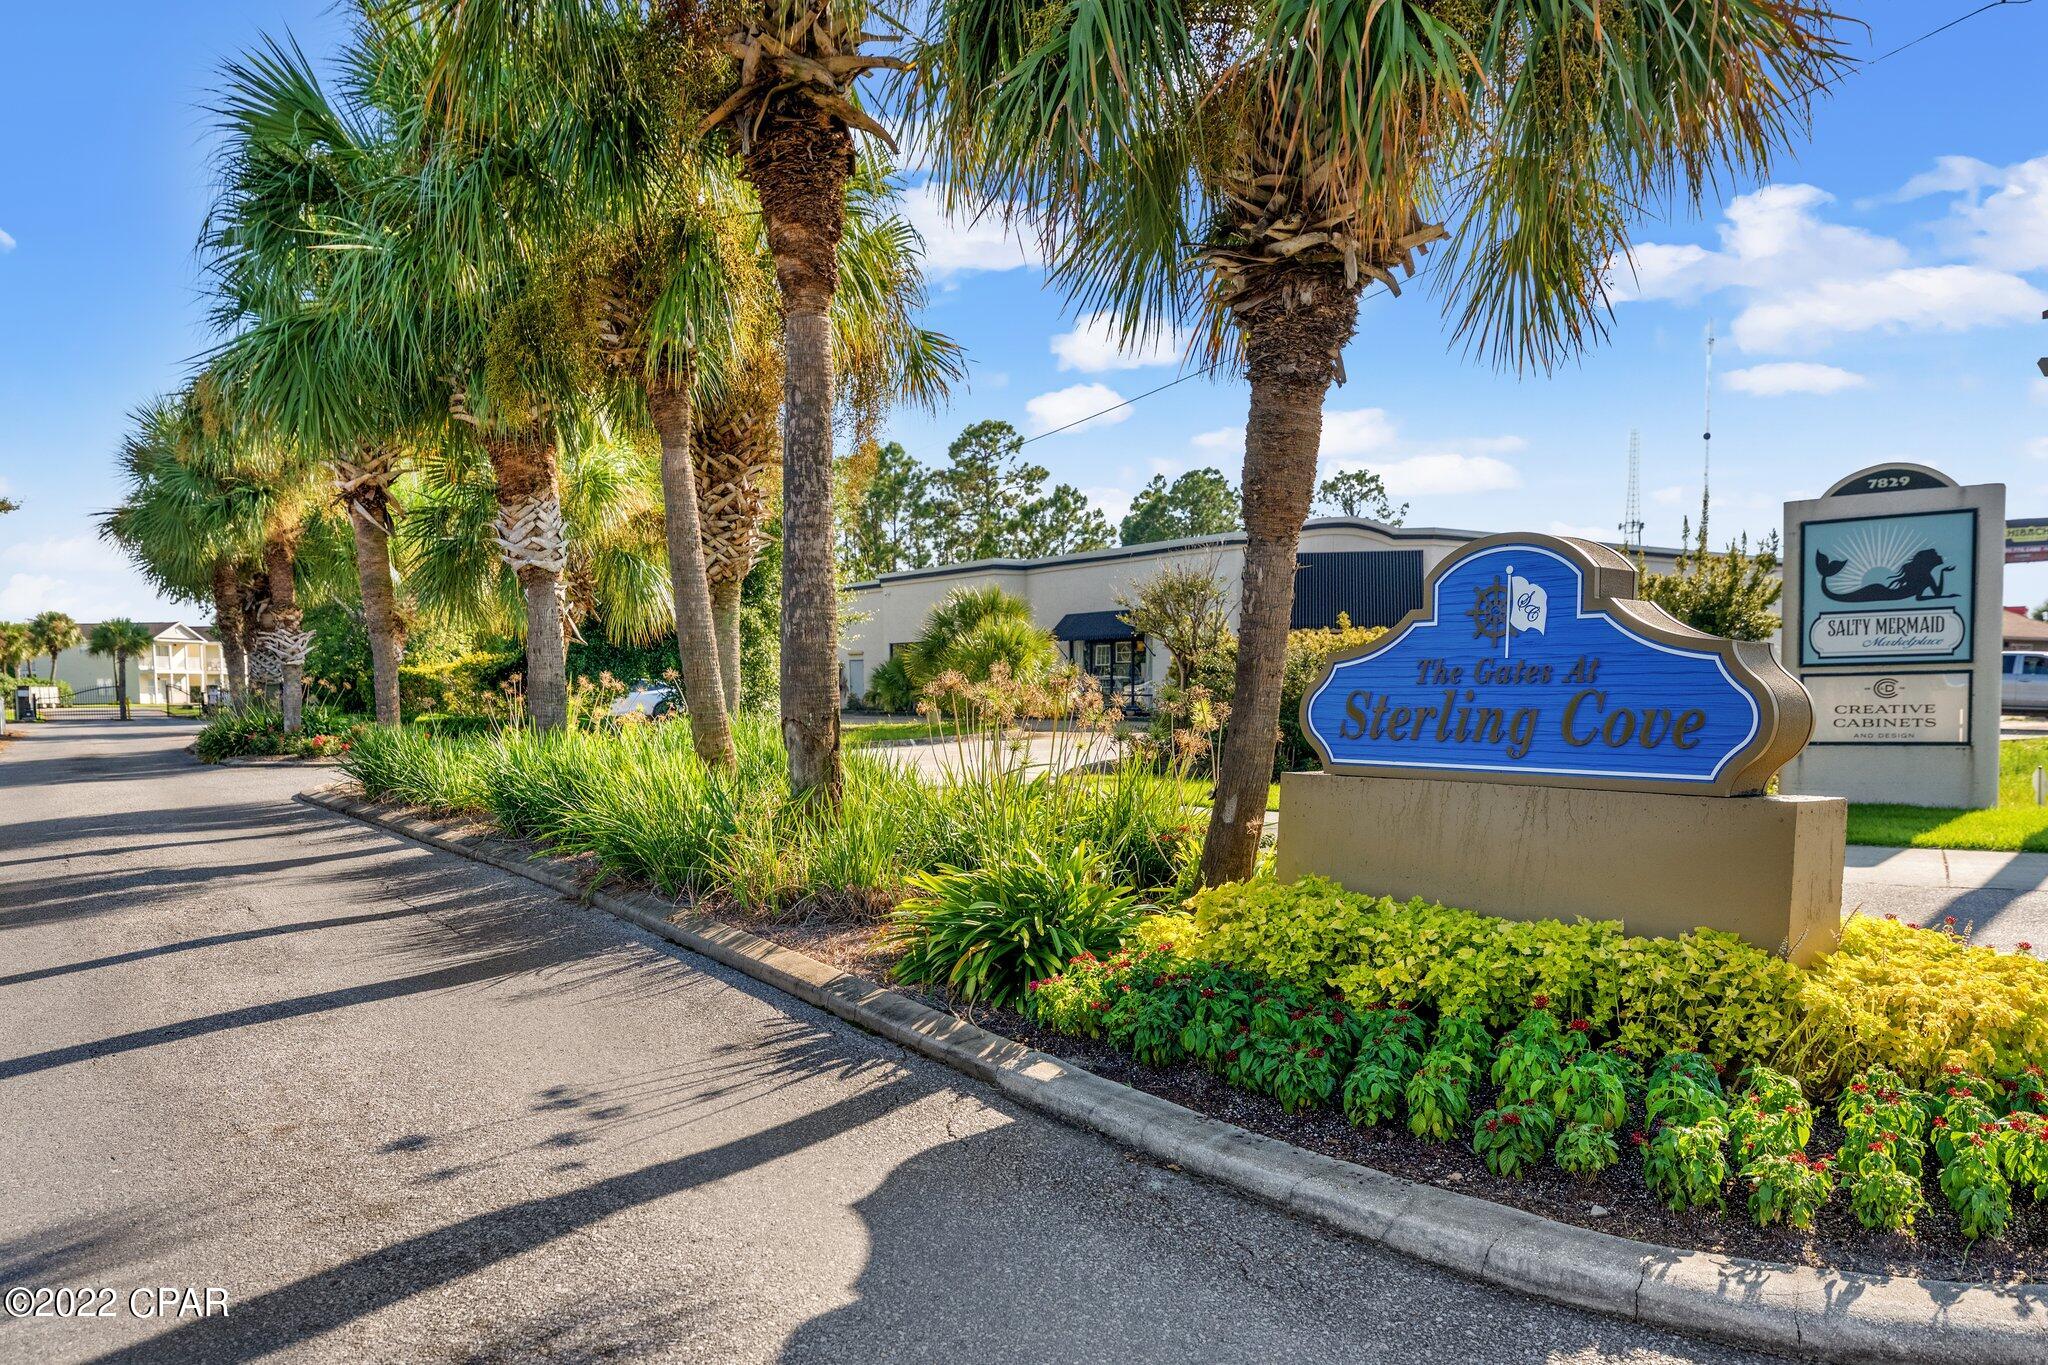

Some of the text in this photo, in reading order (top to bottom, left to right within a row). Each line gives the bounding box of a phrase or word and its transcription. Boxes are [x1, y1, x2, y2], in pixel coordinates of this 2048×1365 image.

[1867, 476, 1911, 489] 7829
[1827, 615, 1946, 637] SALTY MERMAID
[1862, 635, 1945, 650] Marketplace
[1416, 654, 1601, 685] The Gates At
[1834, 704, 1937, 715] CREATIVE
[1338, 687, 1707, 760] Sterling Cove
[1833, 718, 1938, 728] CABINETS
